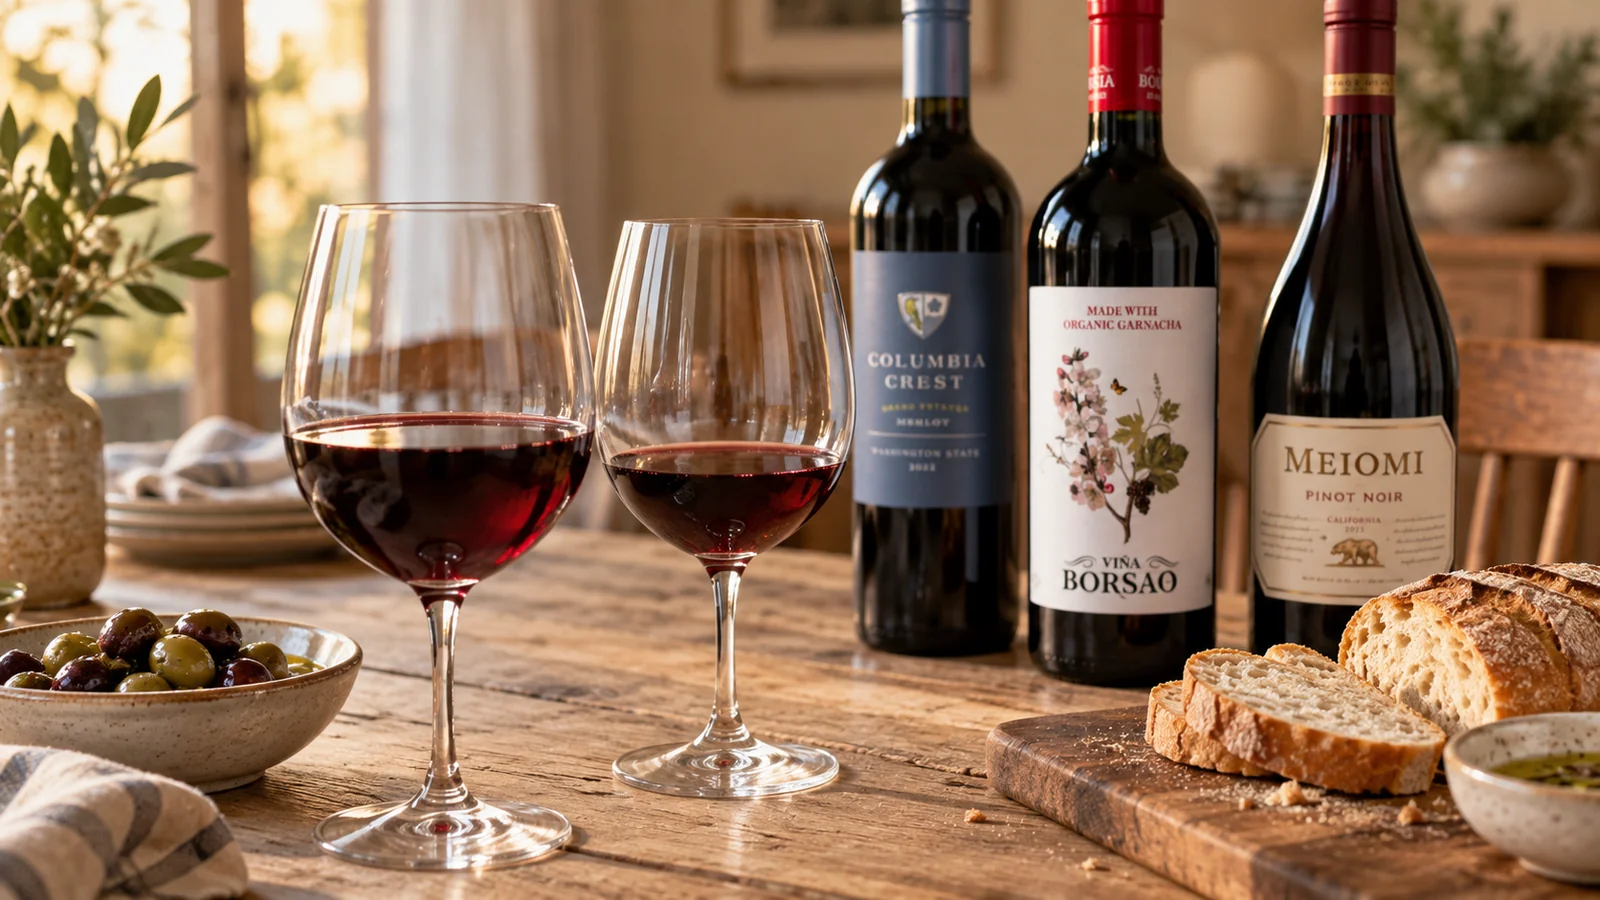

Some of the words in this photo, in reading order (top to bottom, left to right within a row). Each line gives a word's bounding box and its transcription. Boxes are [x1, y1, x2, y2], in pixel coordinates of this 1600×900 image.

[1087, 305, 1122, 317] MADE
[1124, 305, 1158, 317] WITH
[1063, 319, 1115, 331] ORGANIC
[1117, 319, 1182, 331] GARNACHA
[867, 351, 986, 369] COLUMBIA
[884, 374, 964, 390] CREST
[896, 417, 950, 428] MERLOT
[870, 446, 942, 459] WASHINGTON
[945, 448, 980, 459] STATE
[1284, 446, 1424, 477] MEIOMI
[1305, 489, 1356, 503] PINOT
[1363, 491, 1404, 503] NOIR
[1326, 515, 1382, 525] CALIFORNIA
[1102, 555, 1142, 569] VIÑA
[1062, 569, 1178, 600] BORSAO
